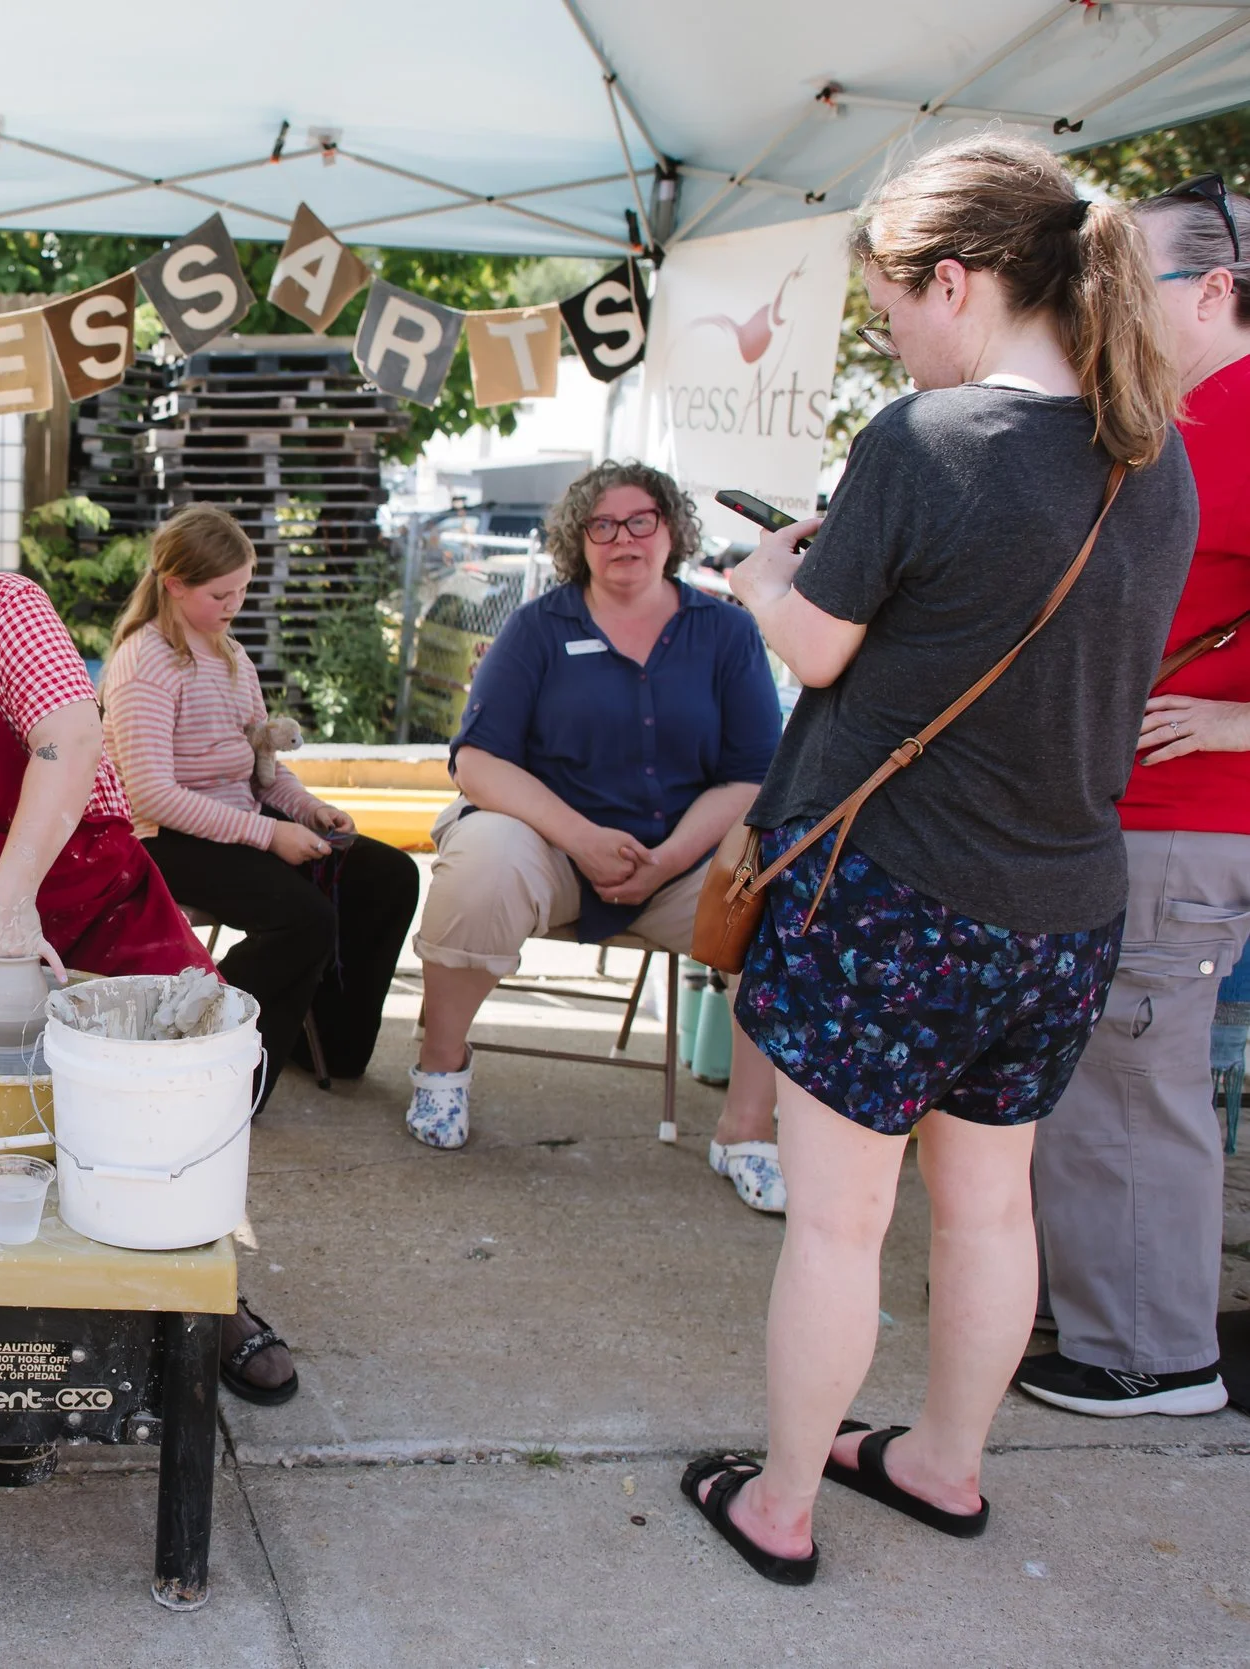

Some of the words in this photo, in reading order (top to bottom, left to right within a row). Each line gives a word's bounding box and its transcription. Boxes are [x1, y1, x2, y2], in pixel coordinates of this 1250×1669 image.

[273, 235, 645, 393] ARTS
[18, 1355, 47, 1364] HOSE
[49, 1356, 70, 1364] OFF
[19, 1364, 68, 1373] CONTROL
[9, 1372, 24, 1380] OR
[27, 1372, 62, 1381] PEDAL
[57, 1389, 108, 1408] CXC
